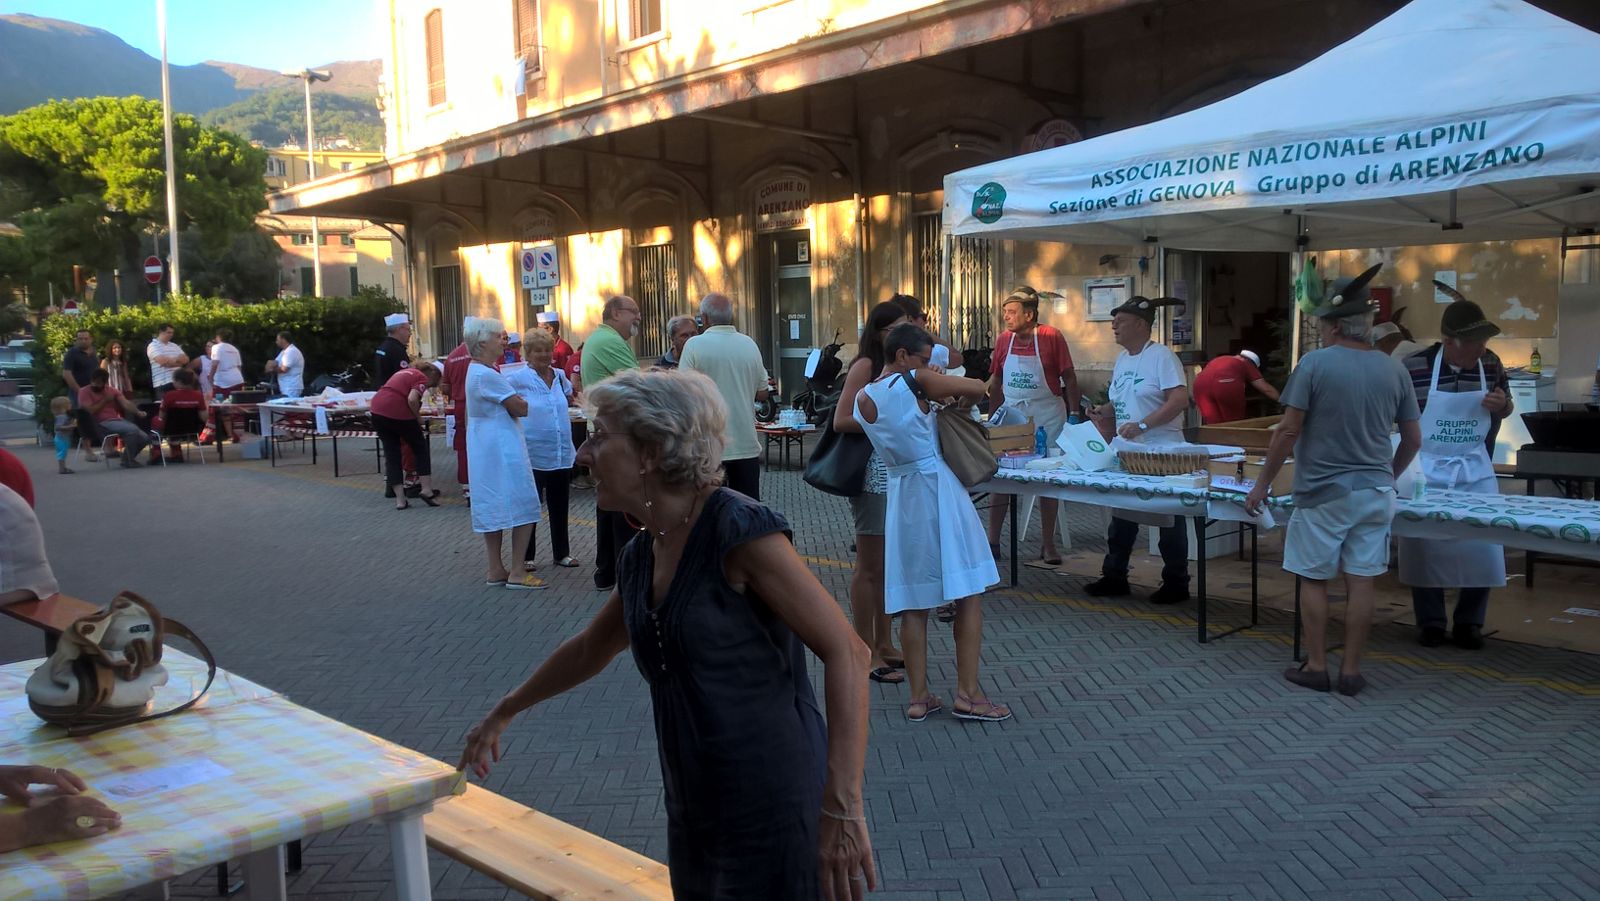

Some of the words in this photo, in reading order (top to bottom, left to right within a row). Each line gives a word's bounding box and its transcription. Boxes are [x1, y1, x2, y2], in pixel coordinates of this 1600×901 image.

[1091, 152, 1240, 189] ASSOCIAZIONE
[1247, 136, 1386, 168] NAZIONALE
[1395, 120, 1487, 151] ALPINI
[1049, 195, 1117, 215] Sezione
[1124, 188, 1143, 207] di
[1149, 180, 1236, 203] GENOVA
[1257, 172, 1346, 195] Gruppo
[1355, 164, 1379, 185] di
[1388, 142, 1545, 182] ARENZANO
[760, 181, 794, 198] COMUNE
[796, 182, 806, 192] DI
[757, 199, 810, 216] ARENZANO
[1435, 420, 1478, 428] GRUPPO
[1430, 434, 1481, 443] ARENZANO
